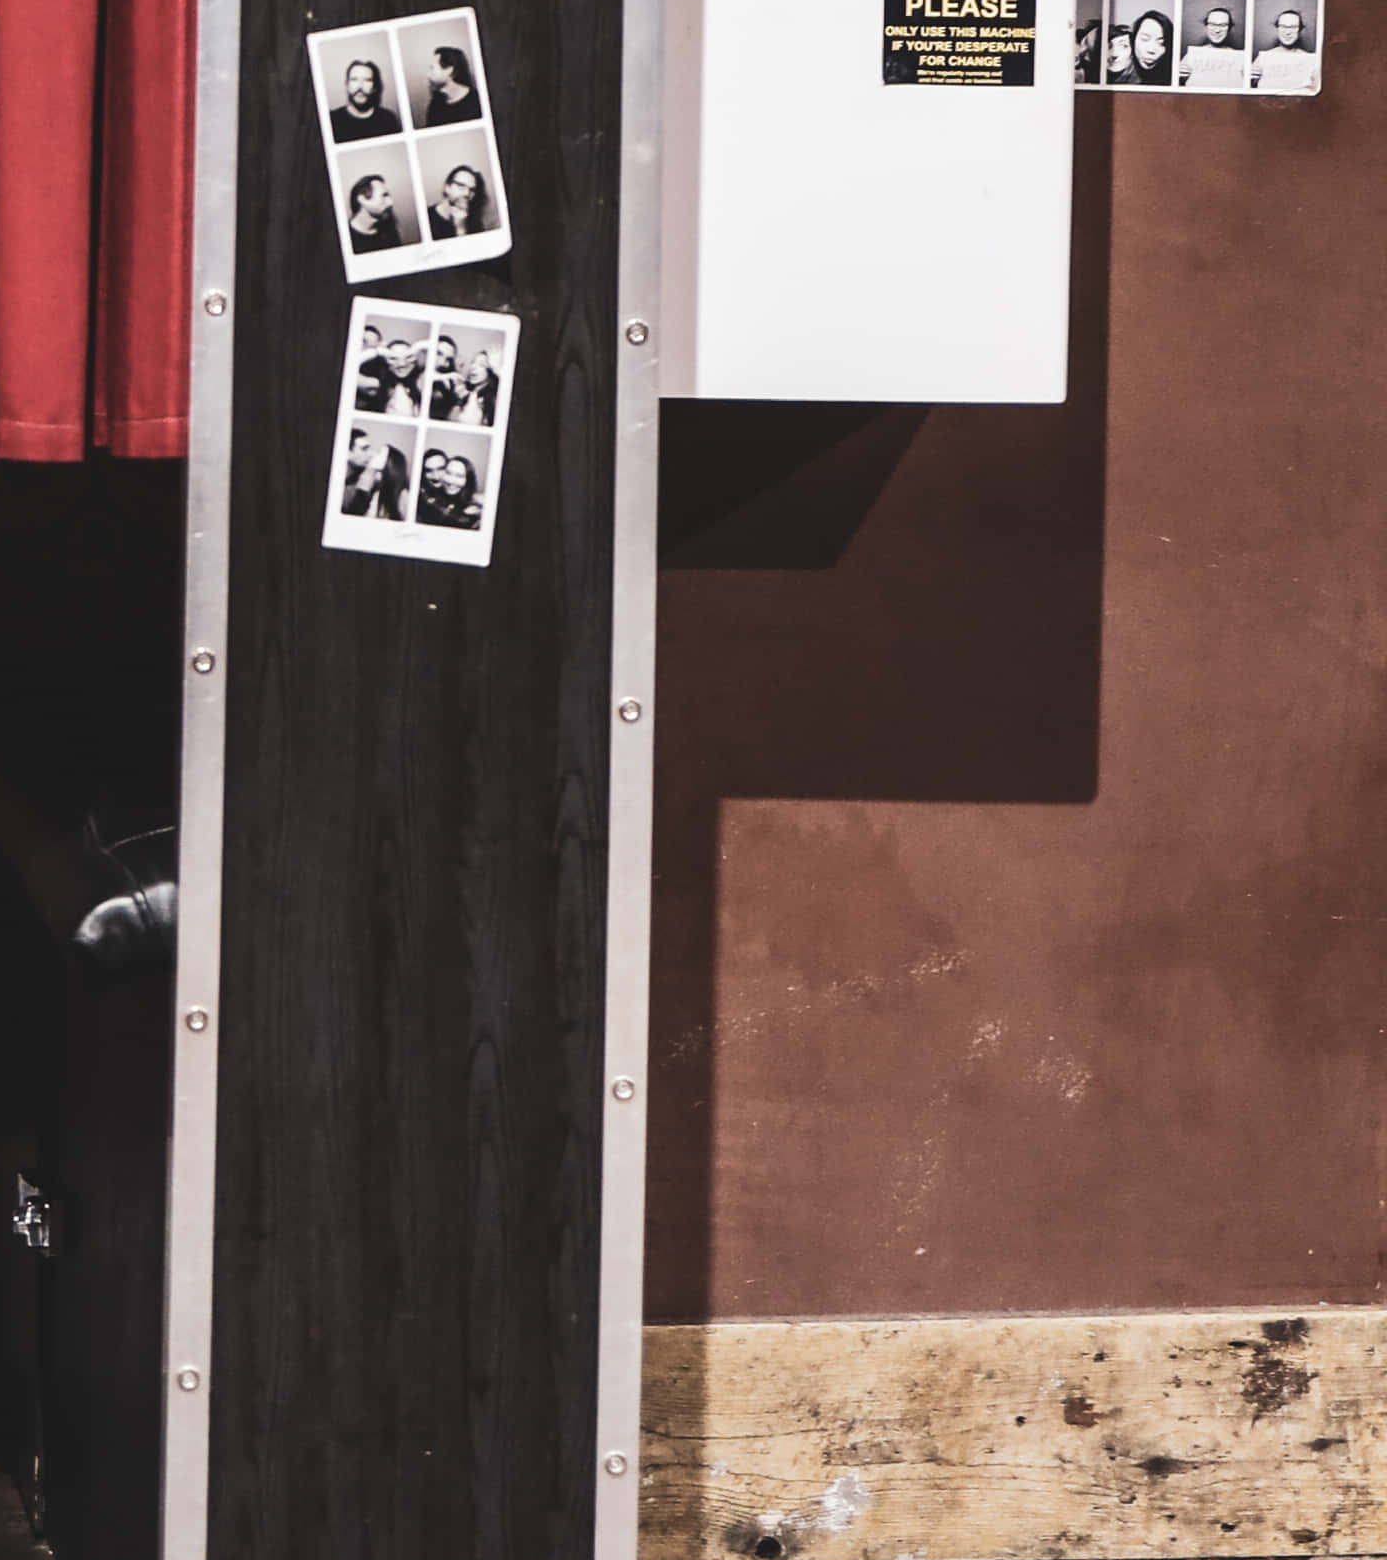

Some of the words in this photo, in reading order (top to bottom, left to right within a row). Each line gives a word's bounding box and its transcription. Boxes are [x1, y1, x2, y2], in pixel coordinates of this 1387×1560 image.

[885, 26, 919, 37] ONLY
[920, 26, 946, 37] USE
[949, 26, 977, 37] THIS
[979, 27, 1035, 38] MACHINE
[892, 40, 904, 51] IF
[906, 41, 953, 52] YOU'RE
[955, 41, 1029, 53] DESPERATE
[918, 55, 946, 66] FOR
[948, 56, 1002, 67] CHANGE
